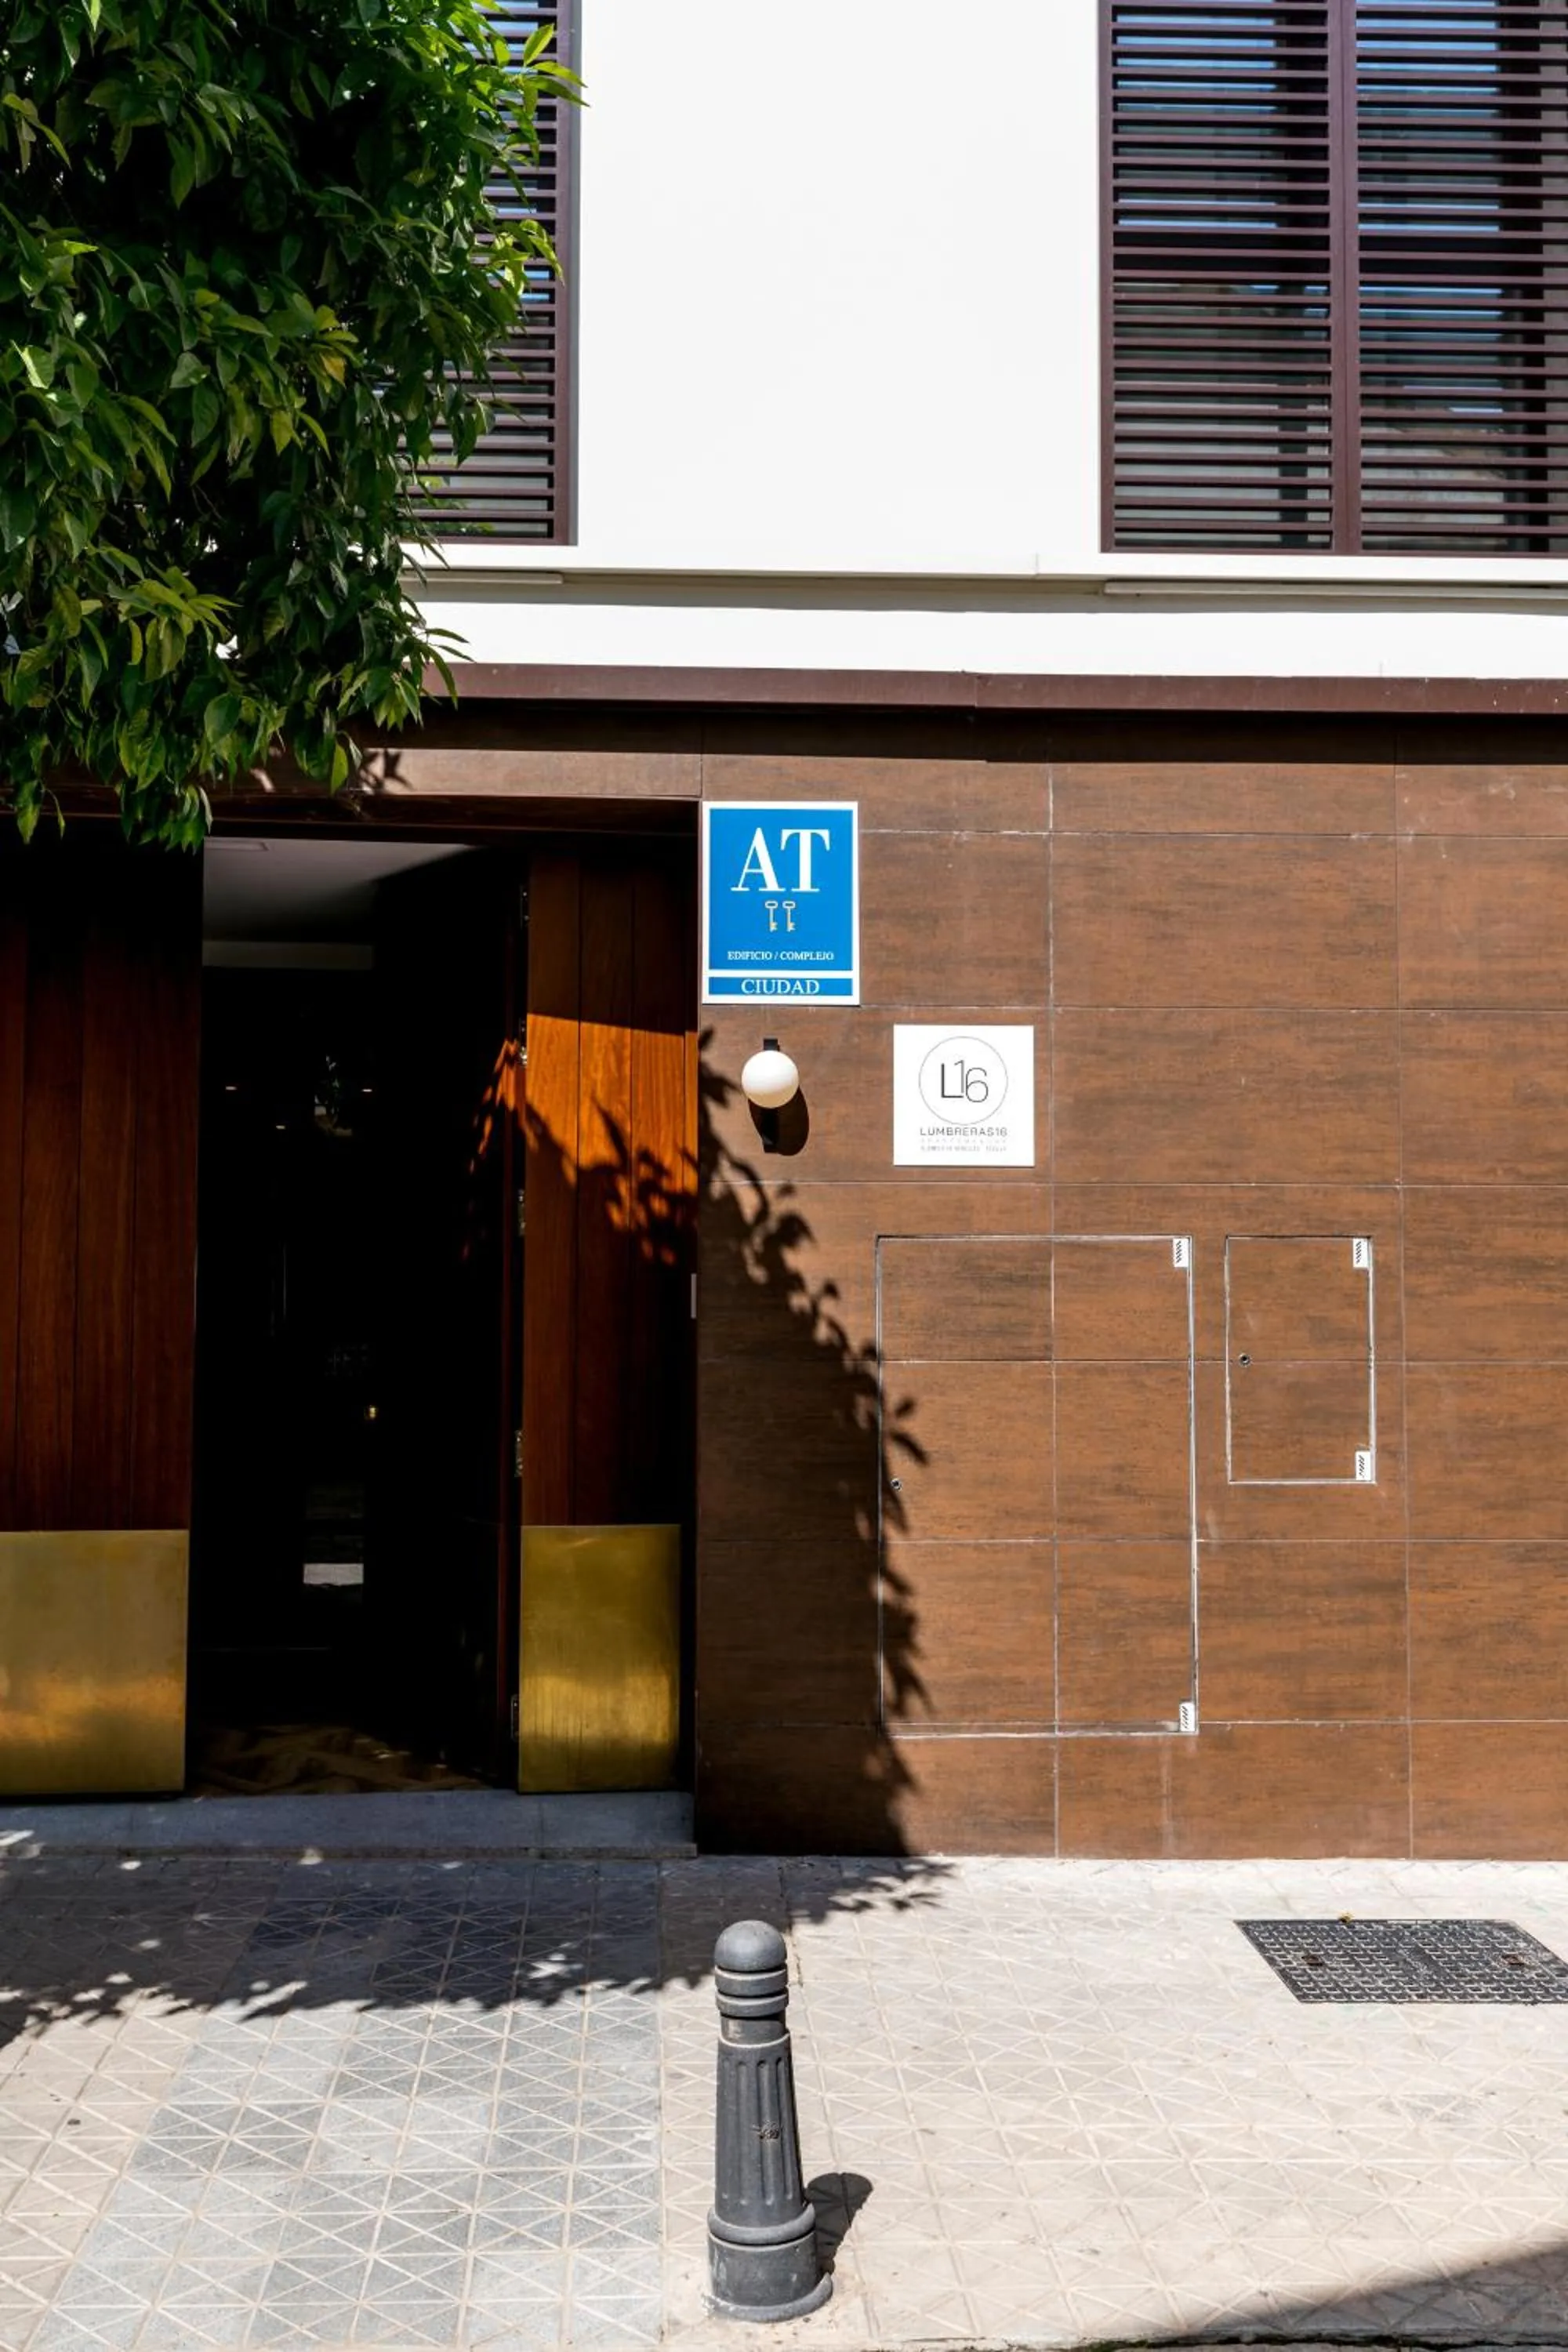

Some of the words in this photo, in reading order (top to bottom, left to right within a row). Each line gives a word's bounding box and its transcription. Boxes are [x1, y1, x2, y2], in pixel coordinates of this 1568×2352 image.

[731, 827, 831, 893] AT
[728, 951, 772, 960] EDIFICIO
[780, 951, 834, 960] COMPLEJO
[741, 978, 819, 995] CIUDAD
[941, 1060, 989, 1103] L16
